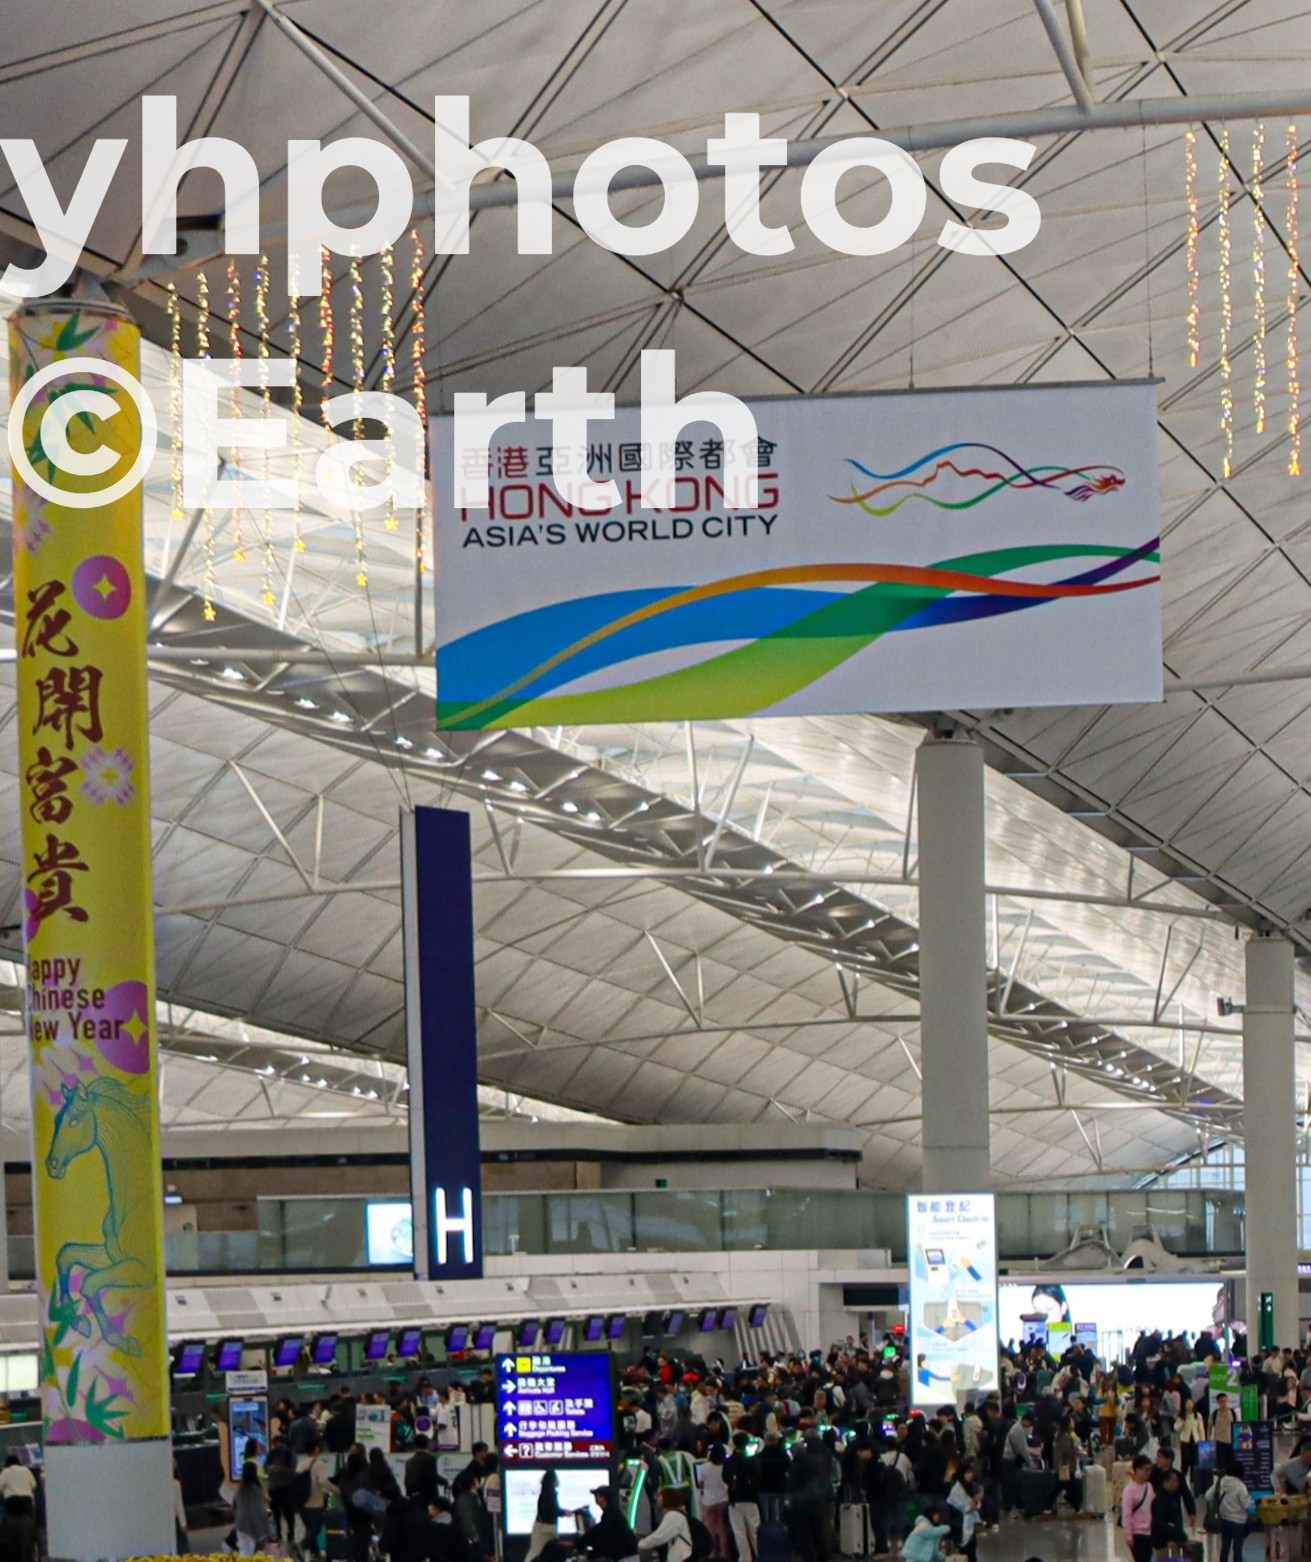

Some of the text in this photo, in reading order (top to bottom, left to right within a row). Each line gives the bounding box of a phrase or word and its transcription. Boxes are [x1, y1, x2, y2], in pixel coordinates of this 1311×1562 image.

[461, 473, 780, 522] HONG KONG
[462, 514, 778, 548] ASIA'S WORLD CITY
[32, 957, 80, 987] appy
[32, 984, 106, 1010] hinese
[33, 1011, 124, 1042] ew Year
[436, 1187, 474, 1265] H
[1227, 1369, 1239, 1387] 2
